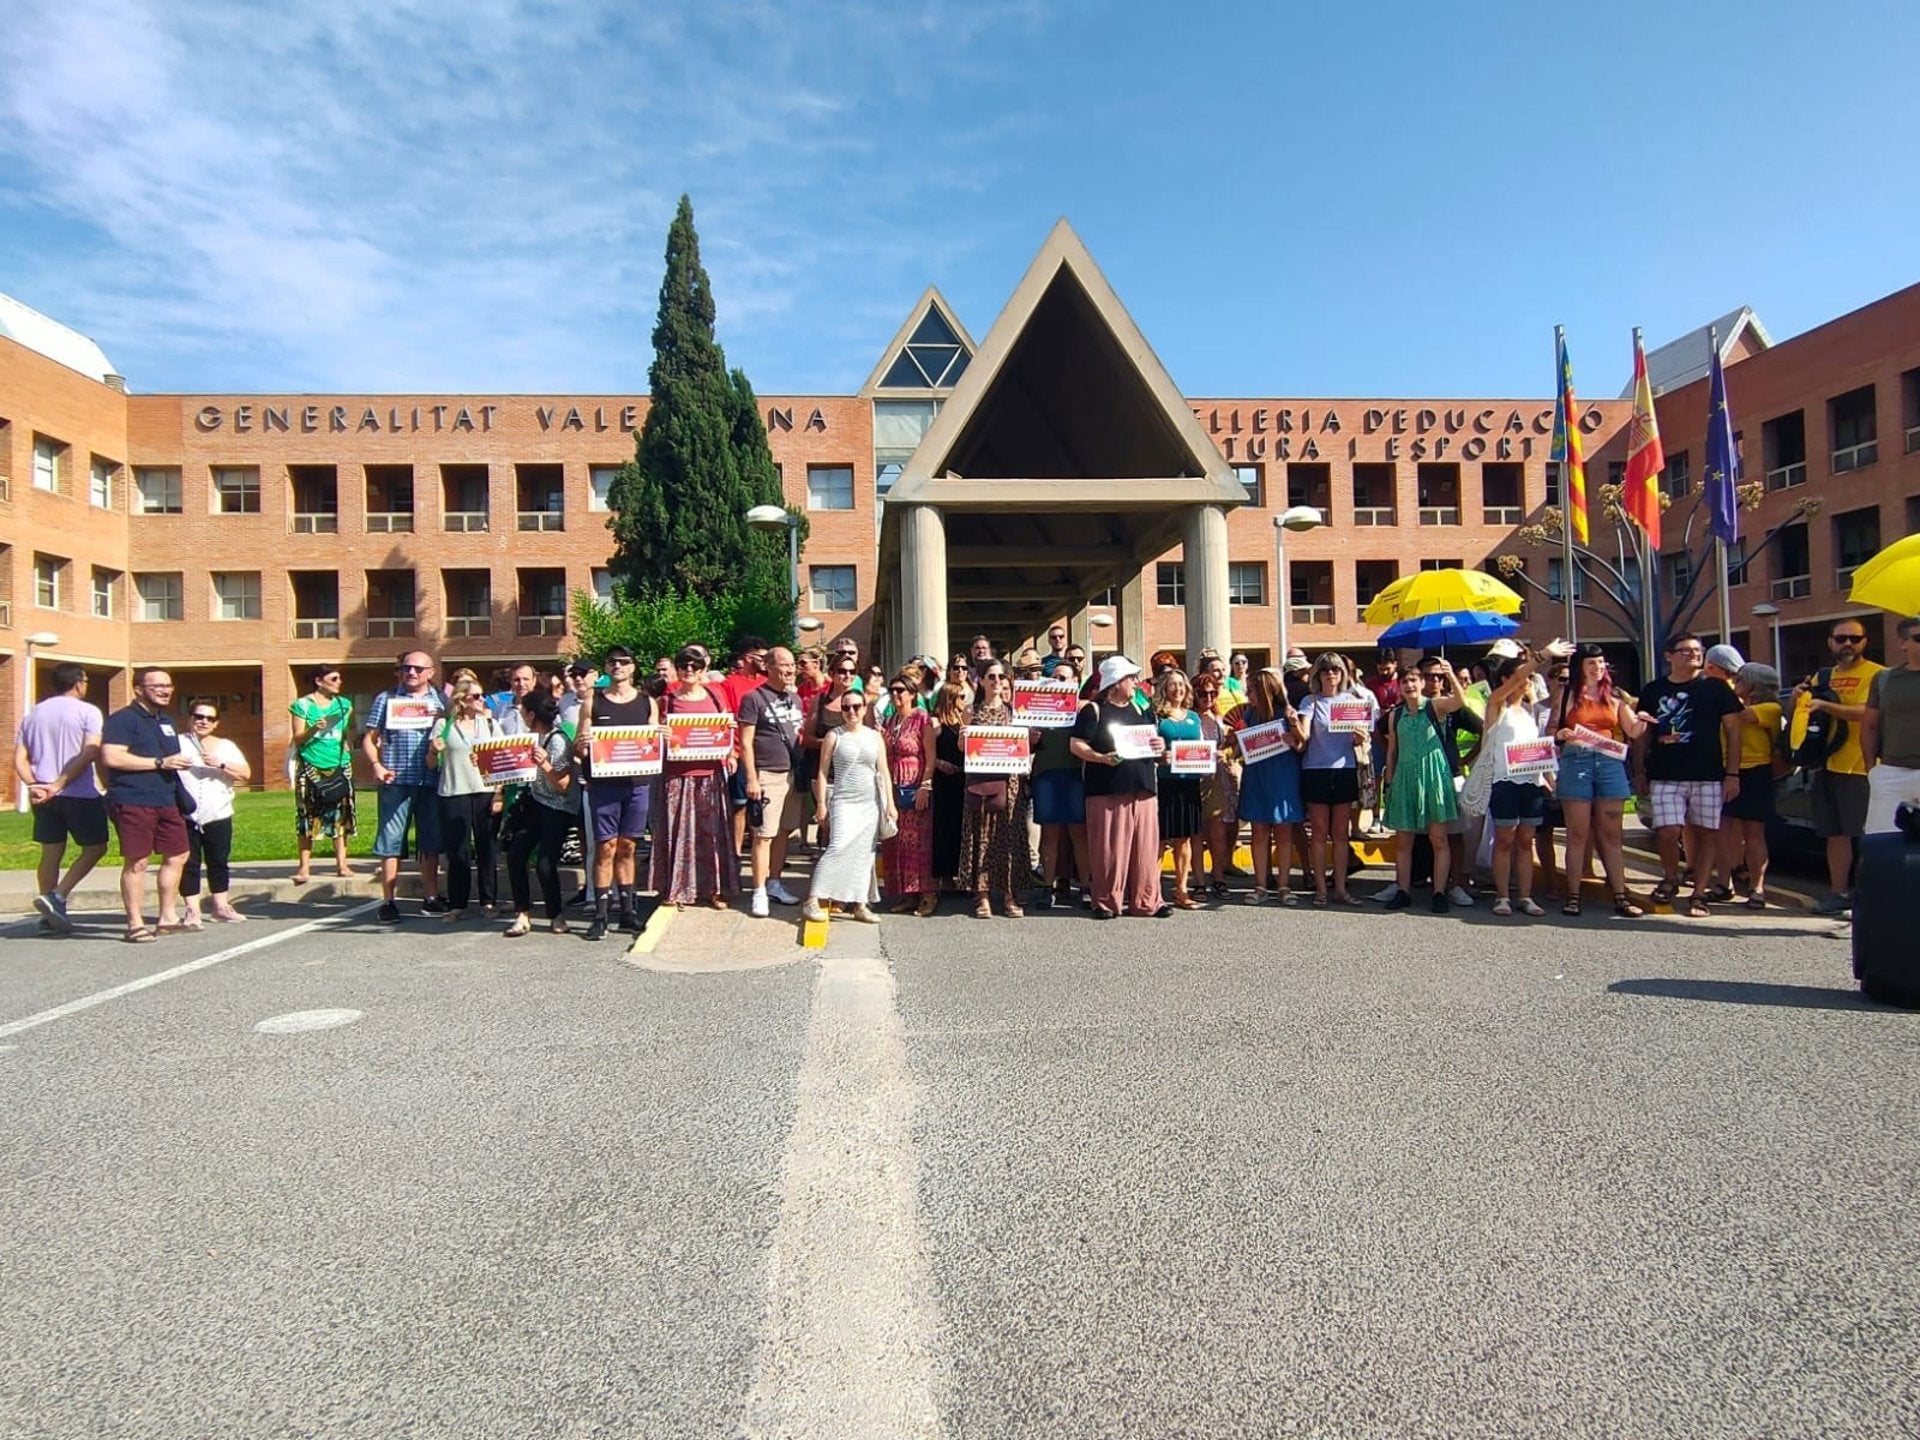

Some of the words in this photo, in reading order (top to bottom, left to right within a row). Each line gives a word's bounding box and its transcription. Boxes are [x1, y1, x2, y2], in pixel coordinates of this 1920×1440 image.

[196, 405, 497, 432] GENERALITAT
[536, 405, 828, 431] VALENA
[1191, 407, 1341, 433] LLERIA
[1364, 403, 1603, 434] D'EDUCACÓ
[1386, 437, 1536, 461] ESPORT
